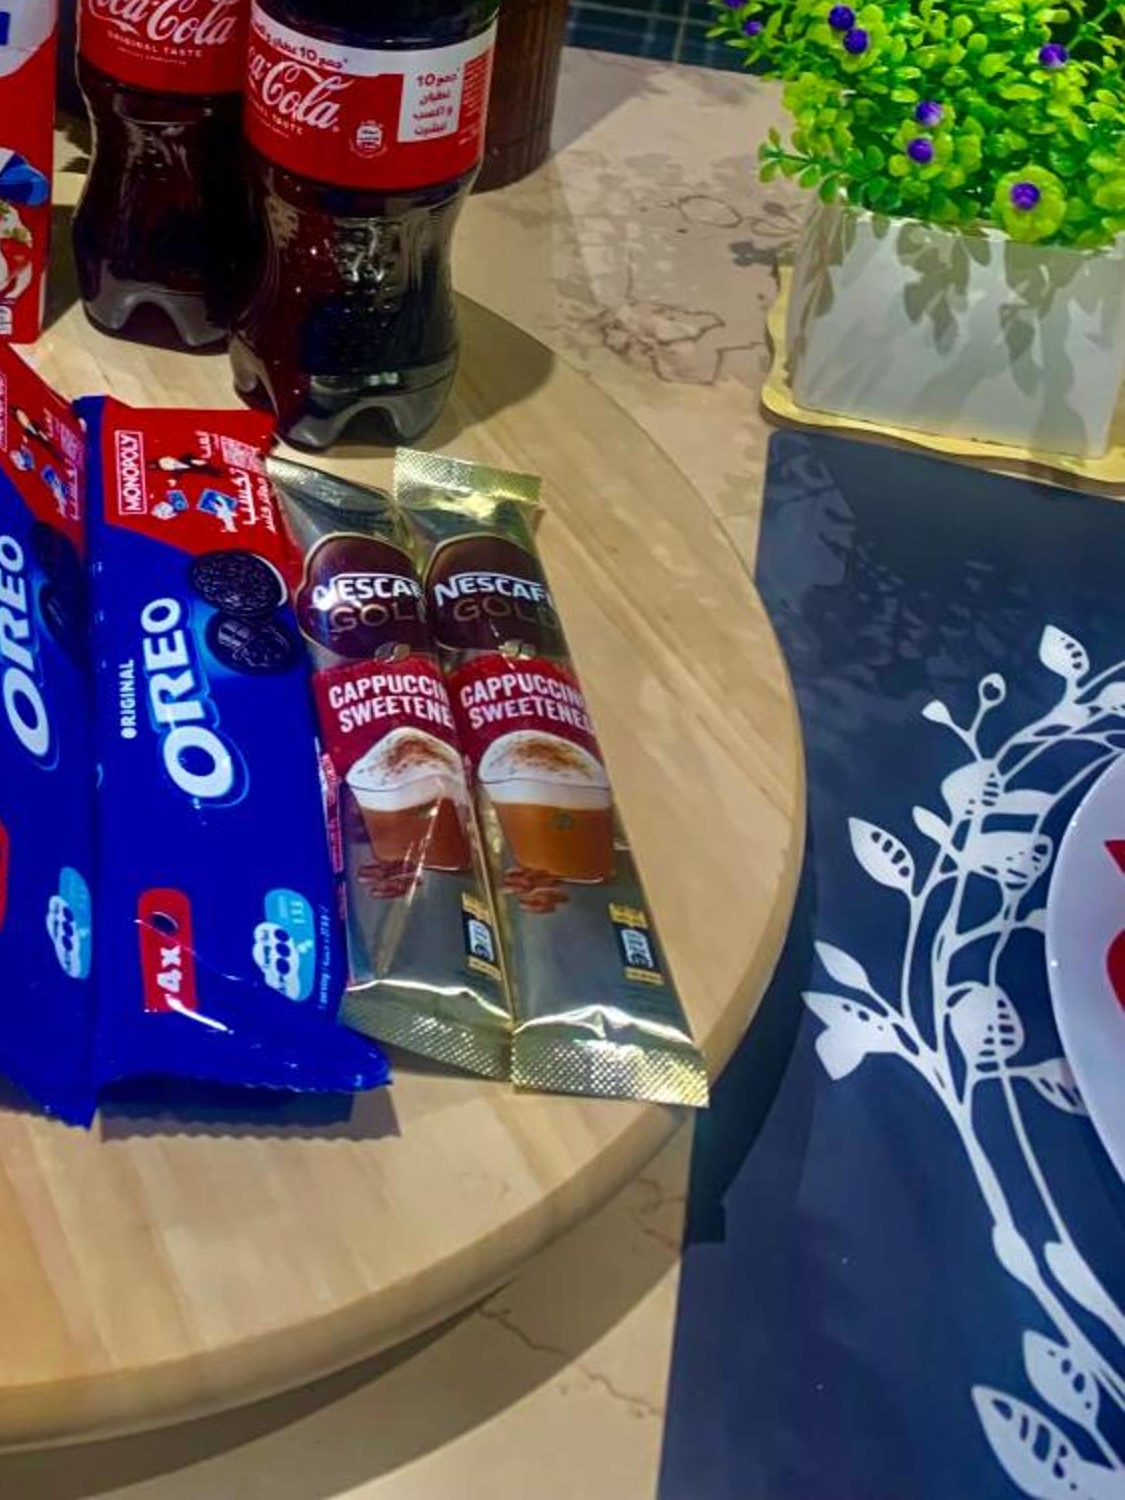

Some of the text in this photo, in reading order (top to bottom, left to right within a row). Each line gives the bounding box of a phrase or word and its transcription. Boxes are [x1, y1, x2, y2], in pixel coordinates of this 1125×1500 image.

[163, 46, 203, 57] TASTE
[299, 46, 317, 61] 10
[417, 73, 435, 87] 10
[120, 433, 141, 512] MONOPOLY
[120, 659, 137, 739] ORIGINAL
[141, 598, 234, 798] OREO
[156, 945, 183, 993] 4x
